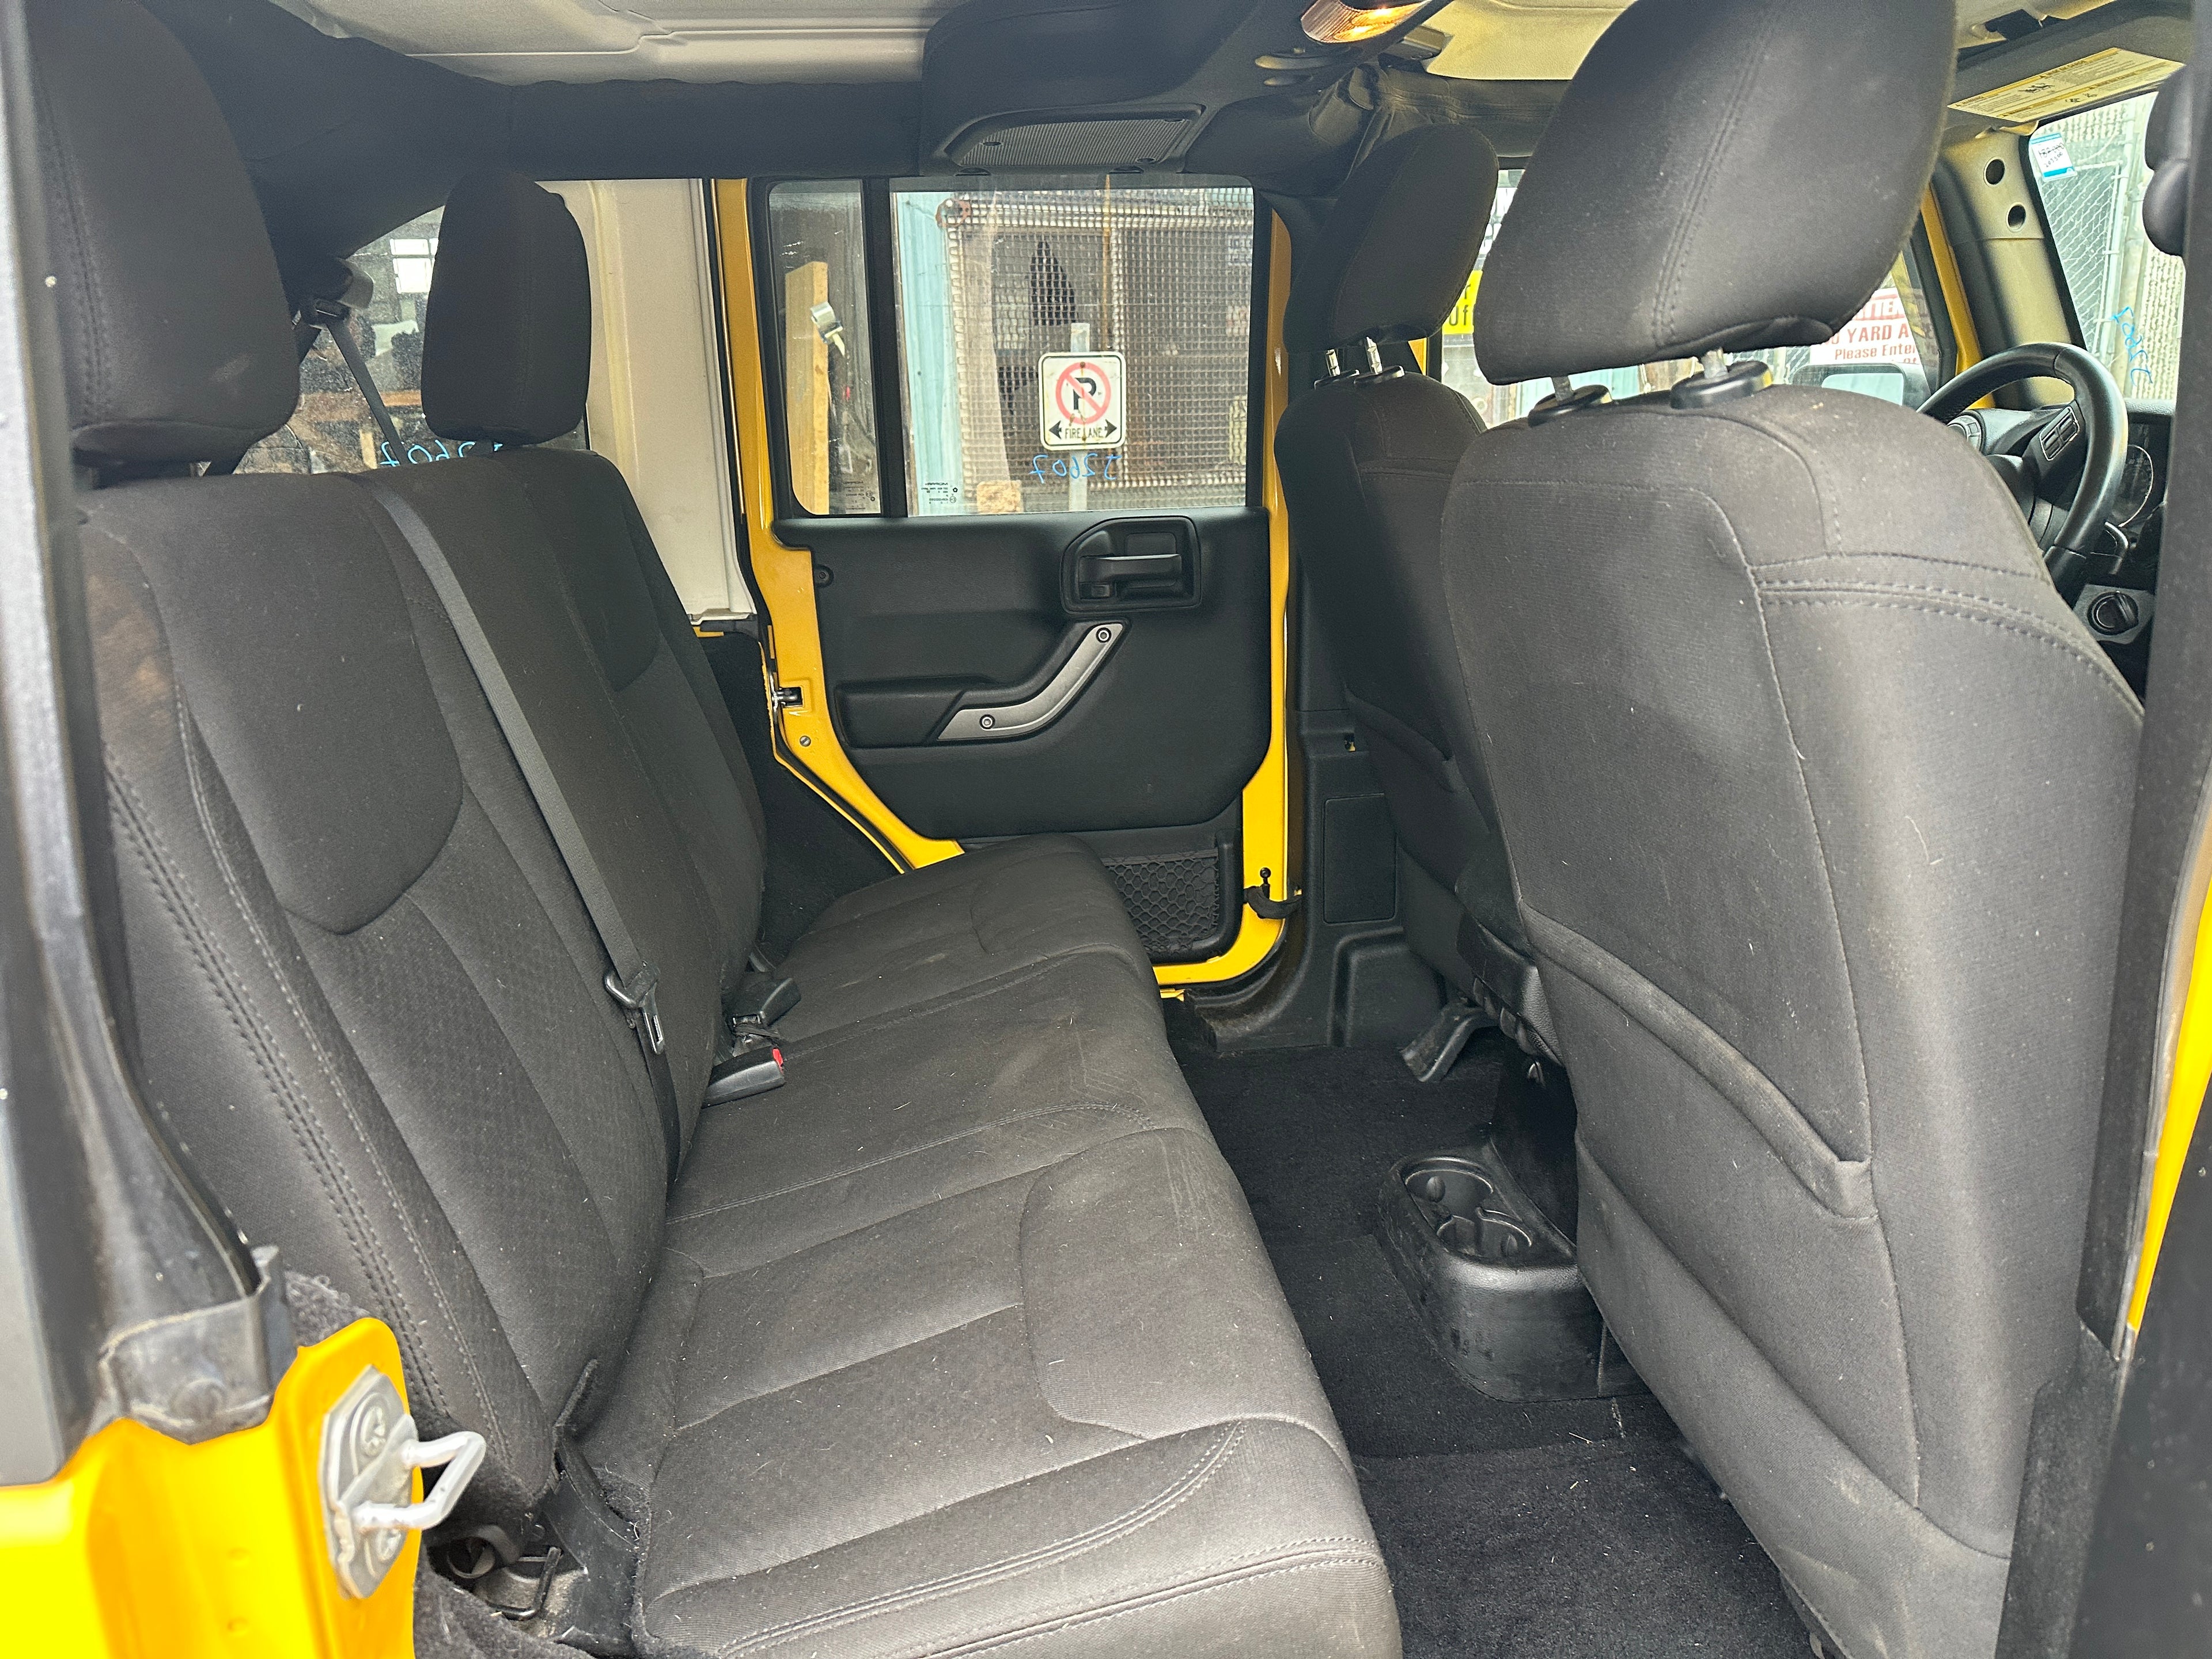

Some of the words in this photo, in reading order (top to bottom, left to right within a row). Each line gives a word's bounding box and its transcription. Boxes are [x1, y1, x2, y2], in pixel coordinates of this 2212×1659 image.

[1847, 324, 1892, 343] YARD
[1835, 347, 1877, 360] Please
[1065, 427, 1081, 439] FIRE
